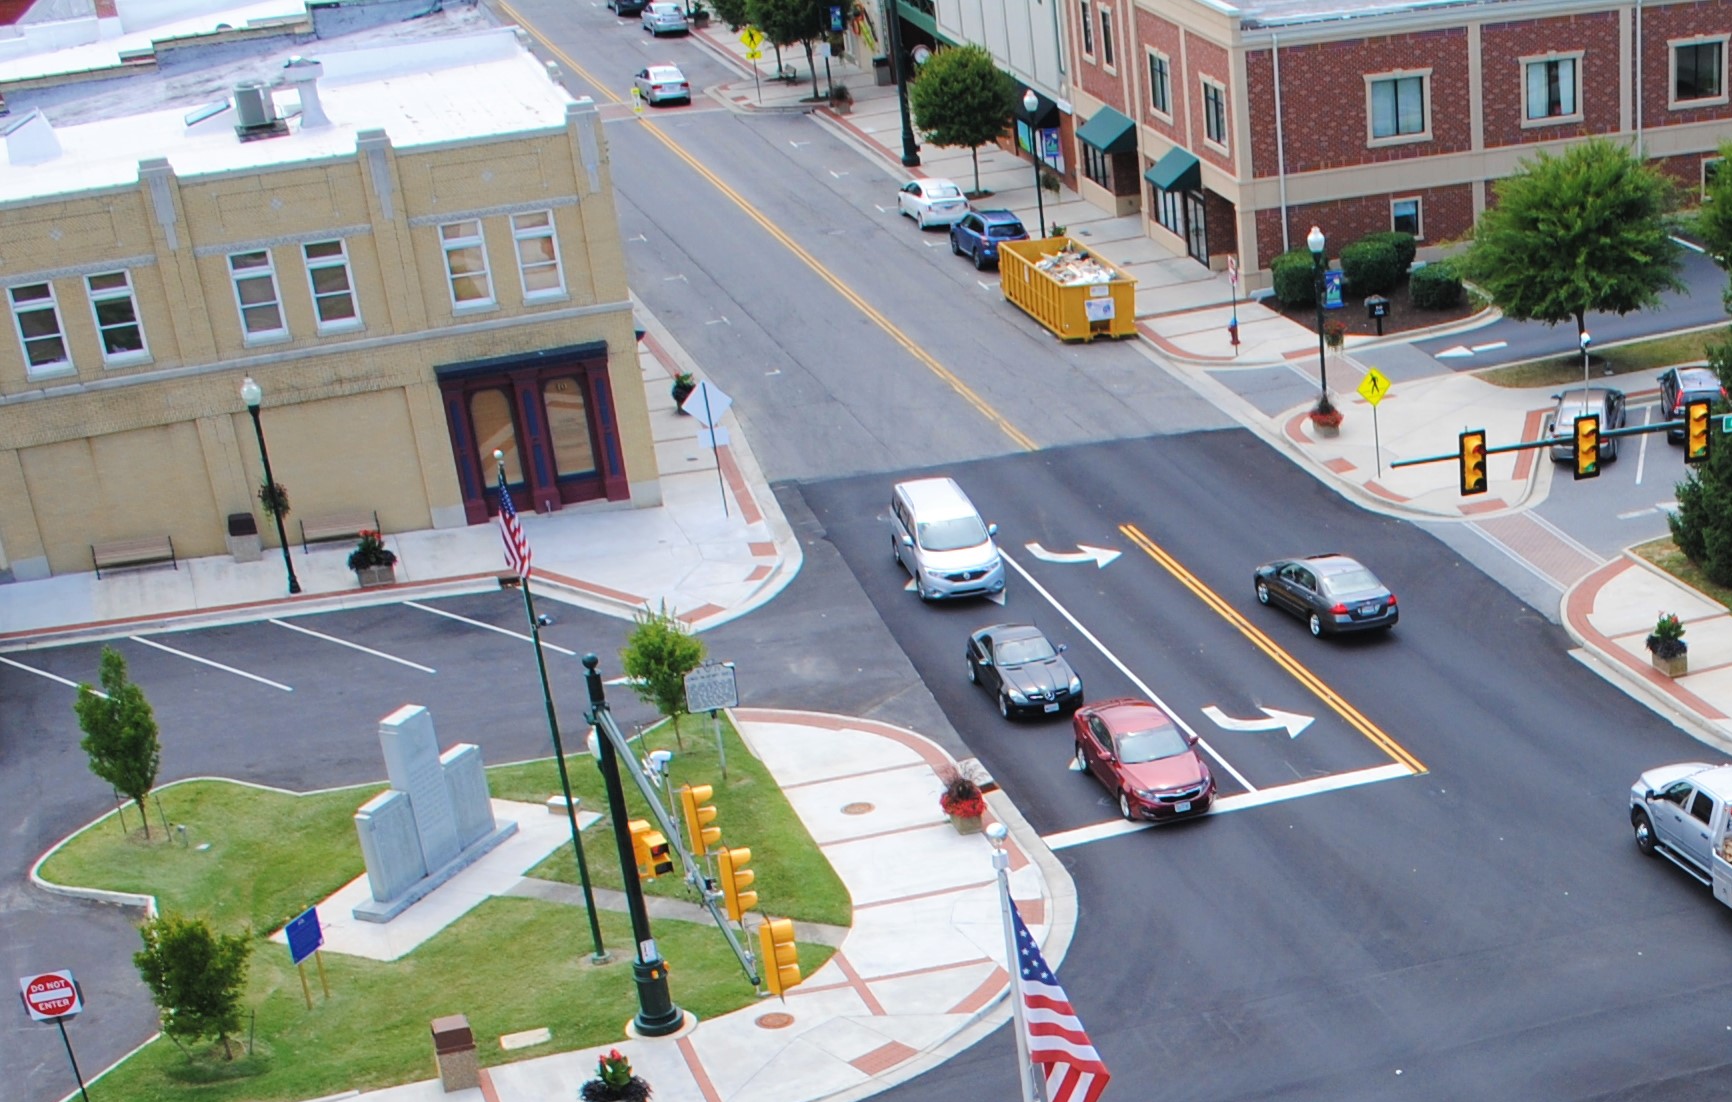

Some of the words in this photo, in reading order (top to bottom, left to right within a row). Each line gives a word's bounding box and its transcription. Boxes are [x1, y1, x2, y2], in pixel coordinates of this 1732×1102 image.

[31, 983, 45, 993] DO
[46, 980, 66, 990] NOT
[38, 998, 70, 1011] ENTER
